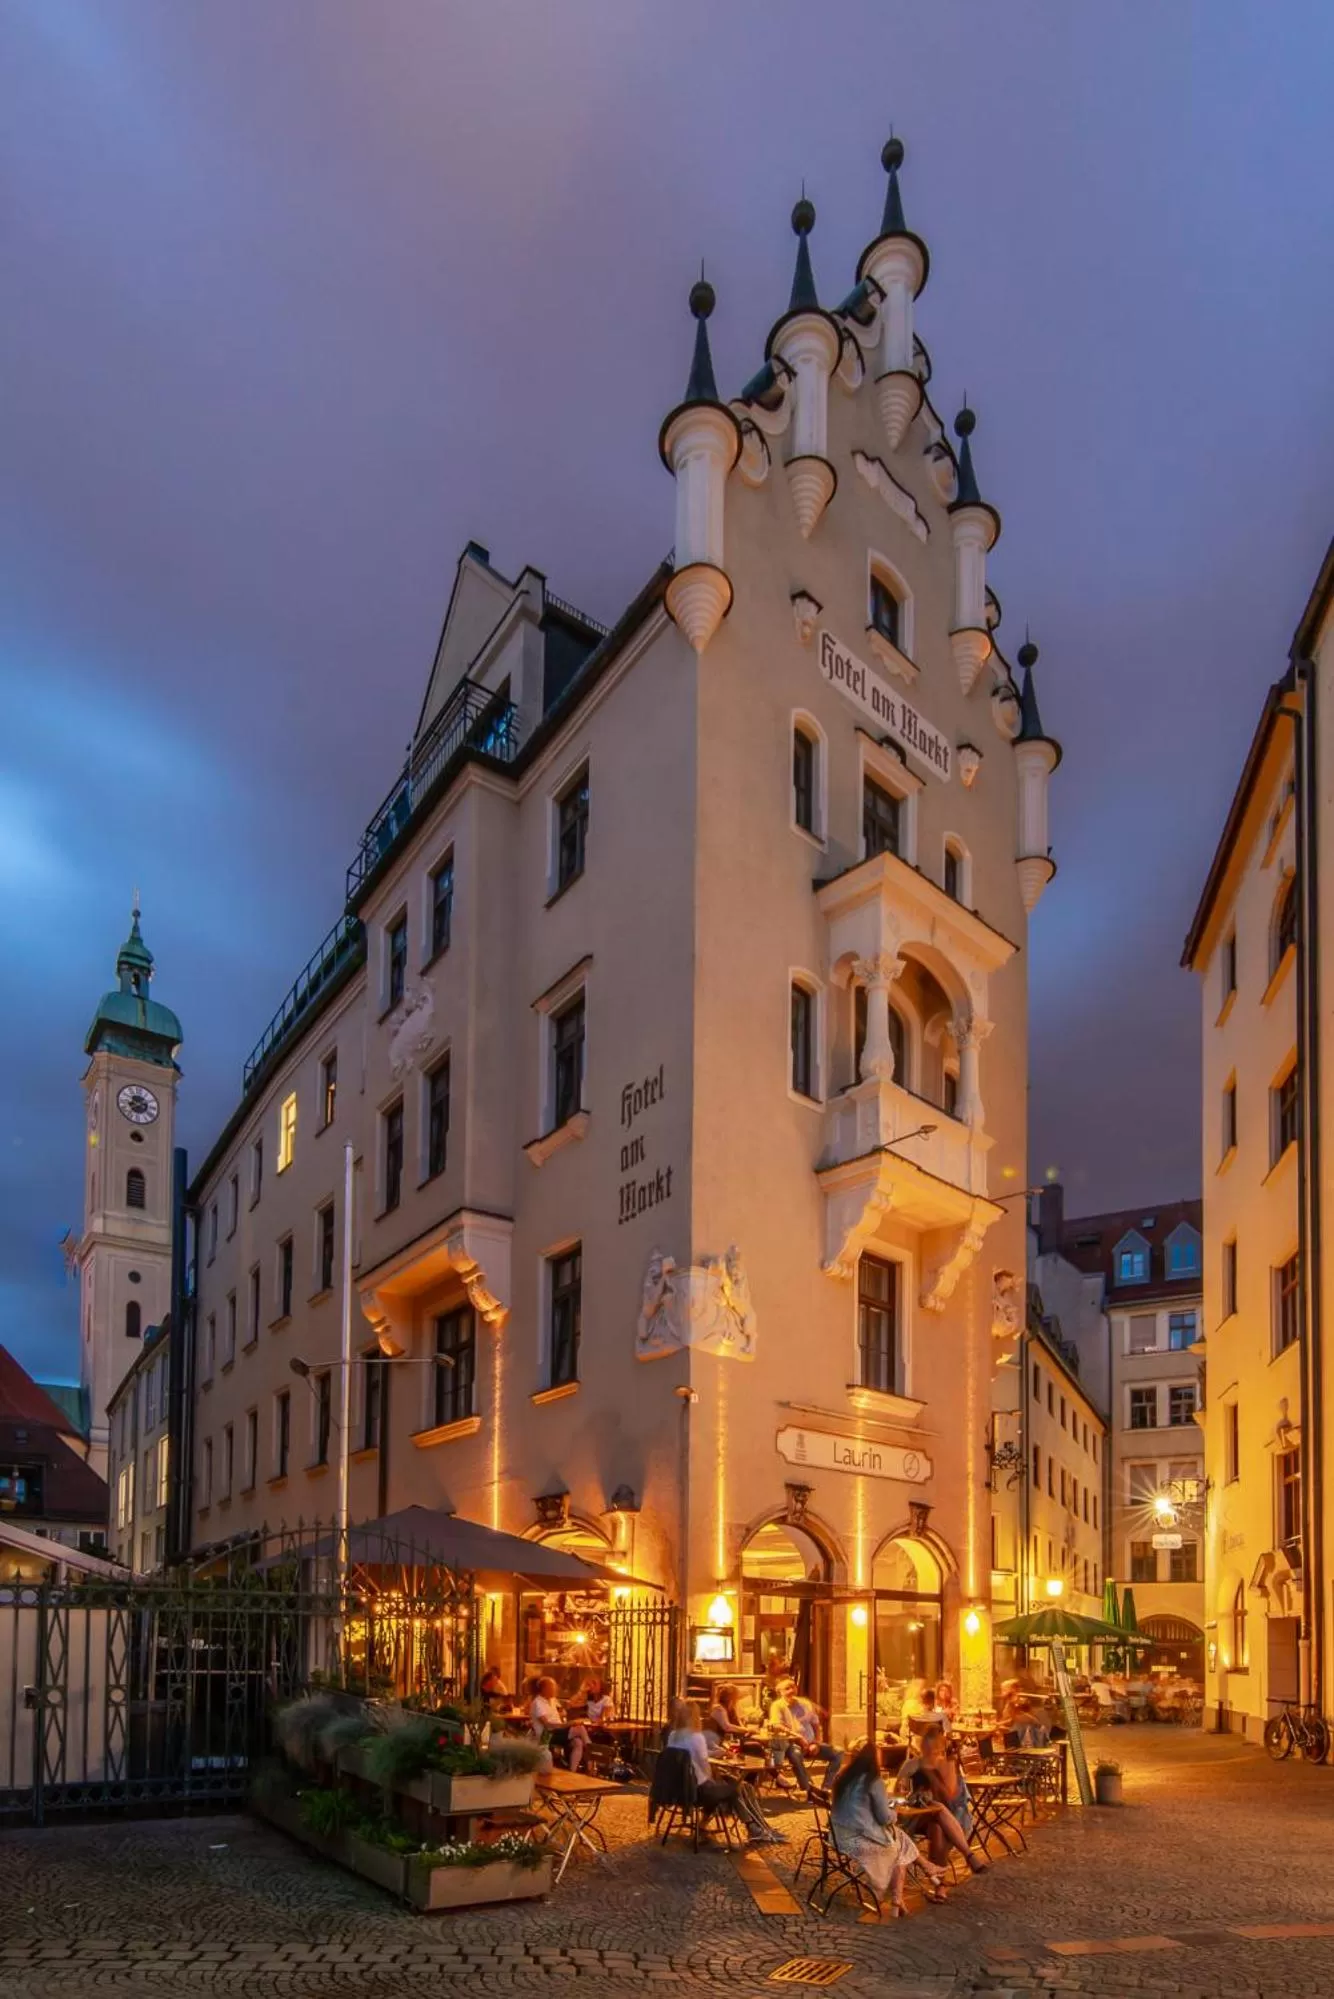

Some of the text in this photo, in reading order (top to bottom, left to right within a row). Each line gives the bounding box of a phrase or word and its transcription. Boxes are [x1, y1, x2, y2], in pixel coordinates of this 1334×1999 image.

[821, 632, 950, 773] Hotel am Markt
[620, 1064, 664, 1129] Hotel
[620, 1135, 645, 1172] am
[618, 1165, 673, 1225] Markt
[832, 1441, 882, 1470] Laurin
